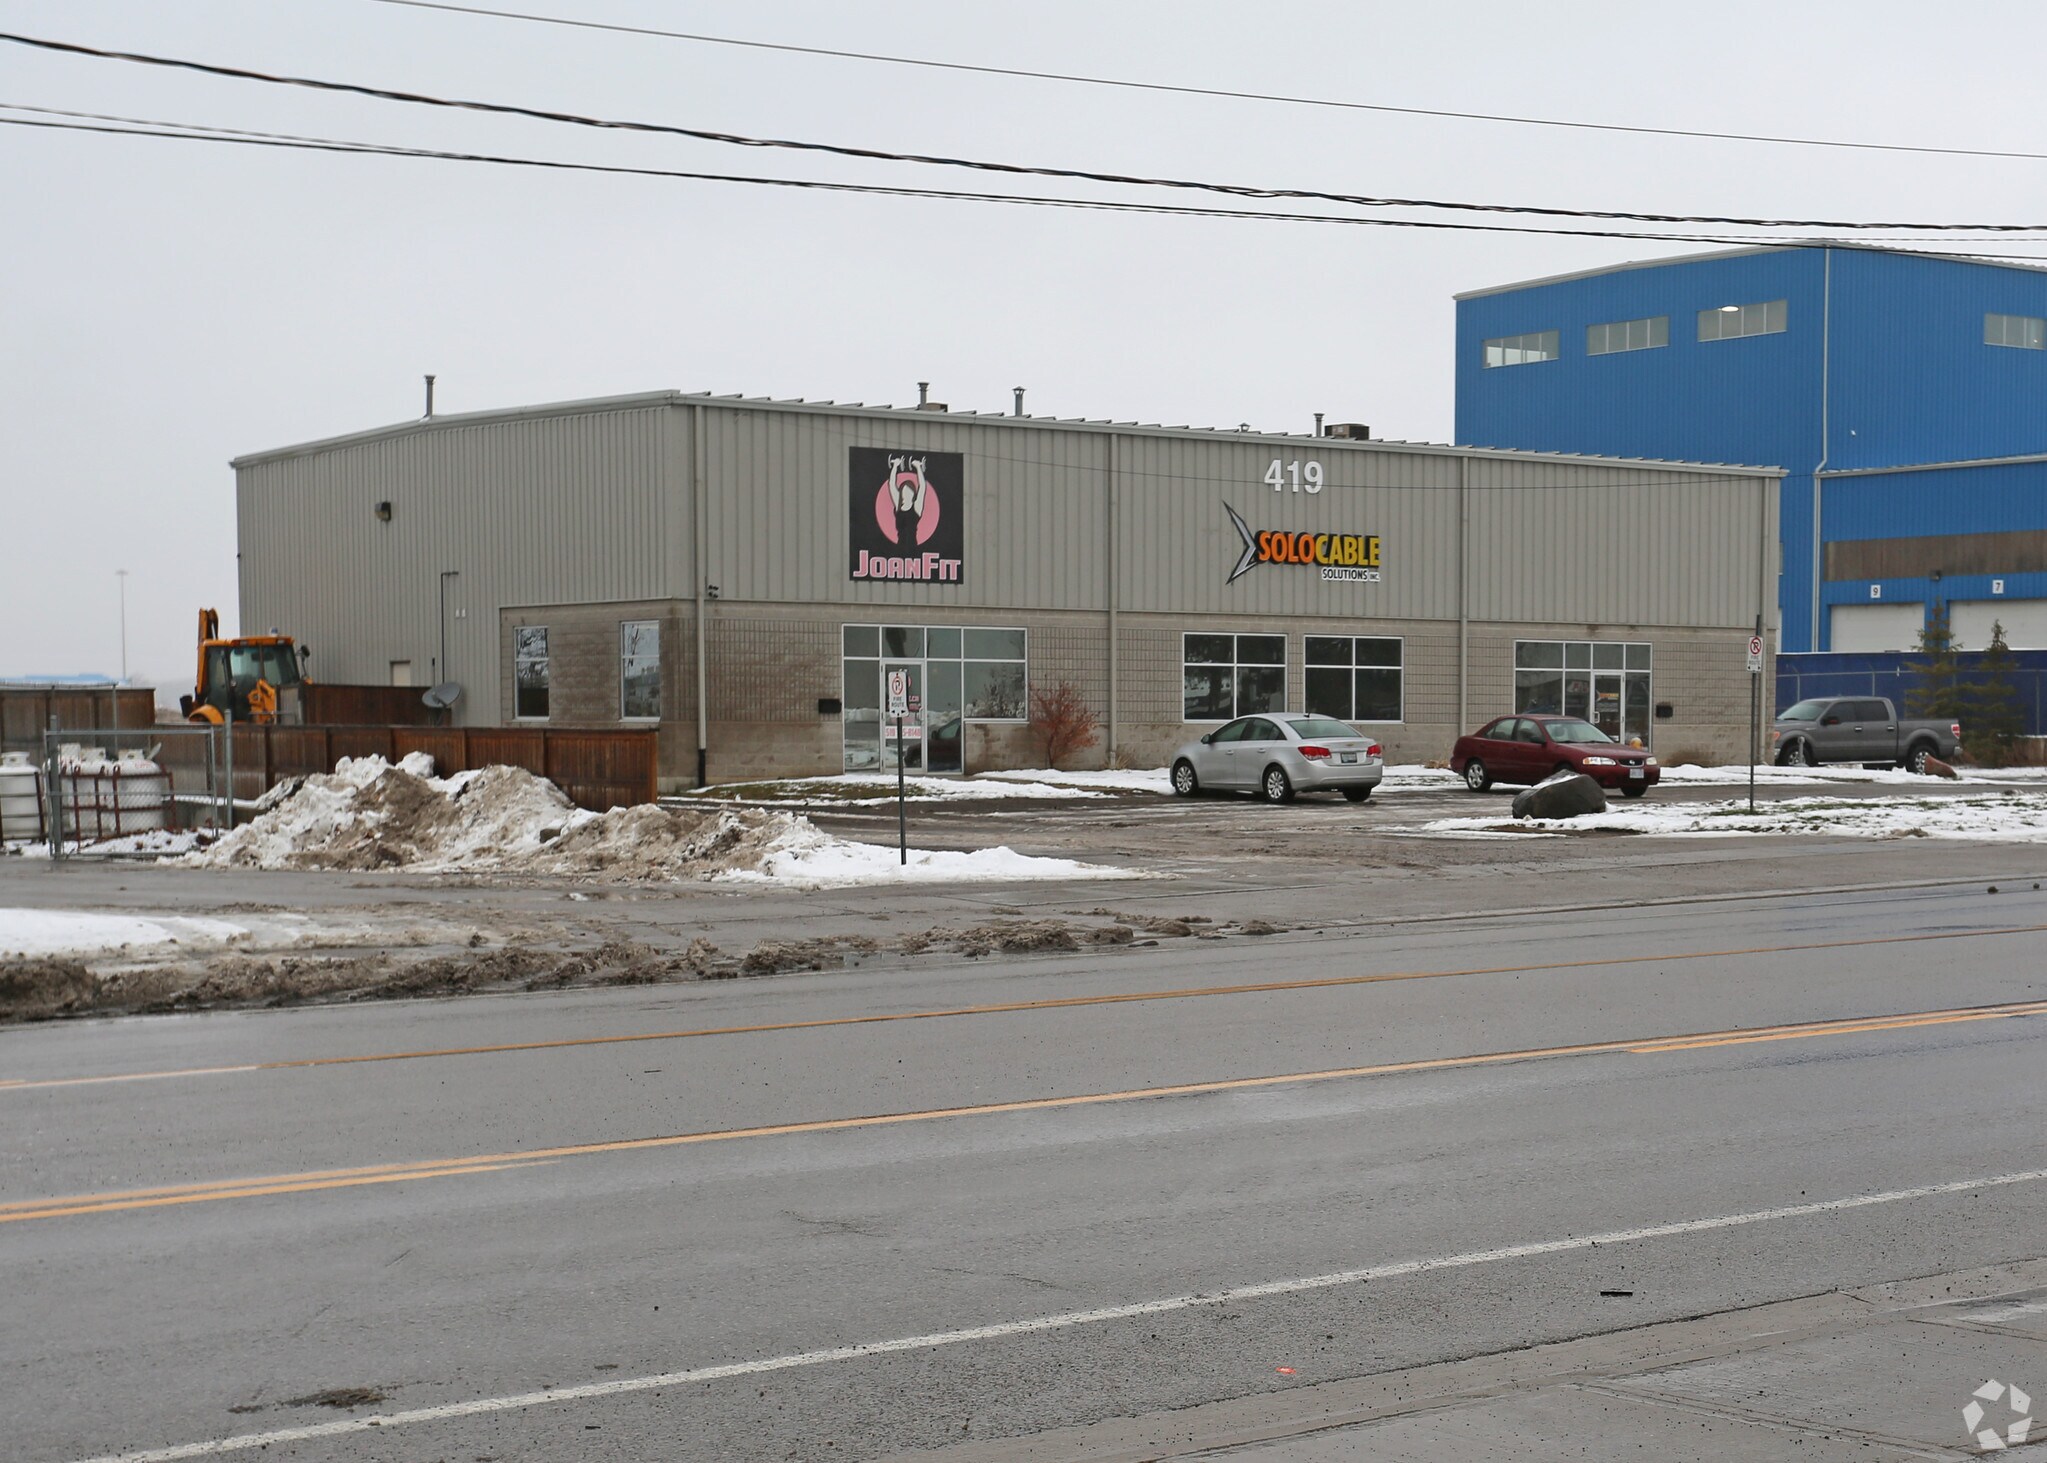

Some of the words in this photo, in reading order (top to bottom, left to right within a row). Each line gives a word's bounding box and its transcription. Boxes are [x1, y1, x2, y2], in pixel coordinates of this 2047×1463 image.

[1264, 459, 1324, 494] 419
[1322, 568, 1368, 580] SOLUTIONS
[1872, 587, 1879, 597] 9
[1995, 582, 2001, 592] 7
